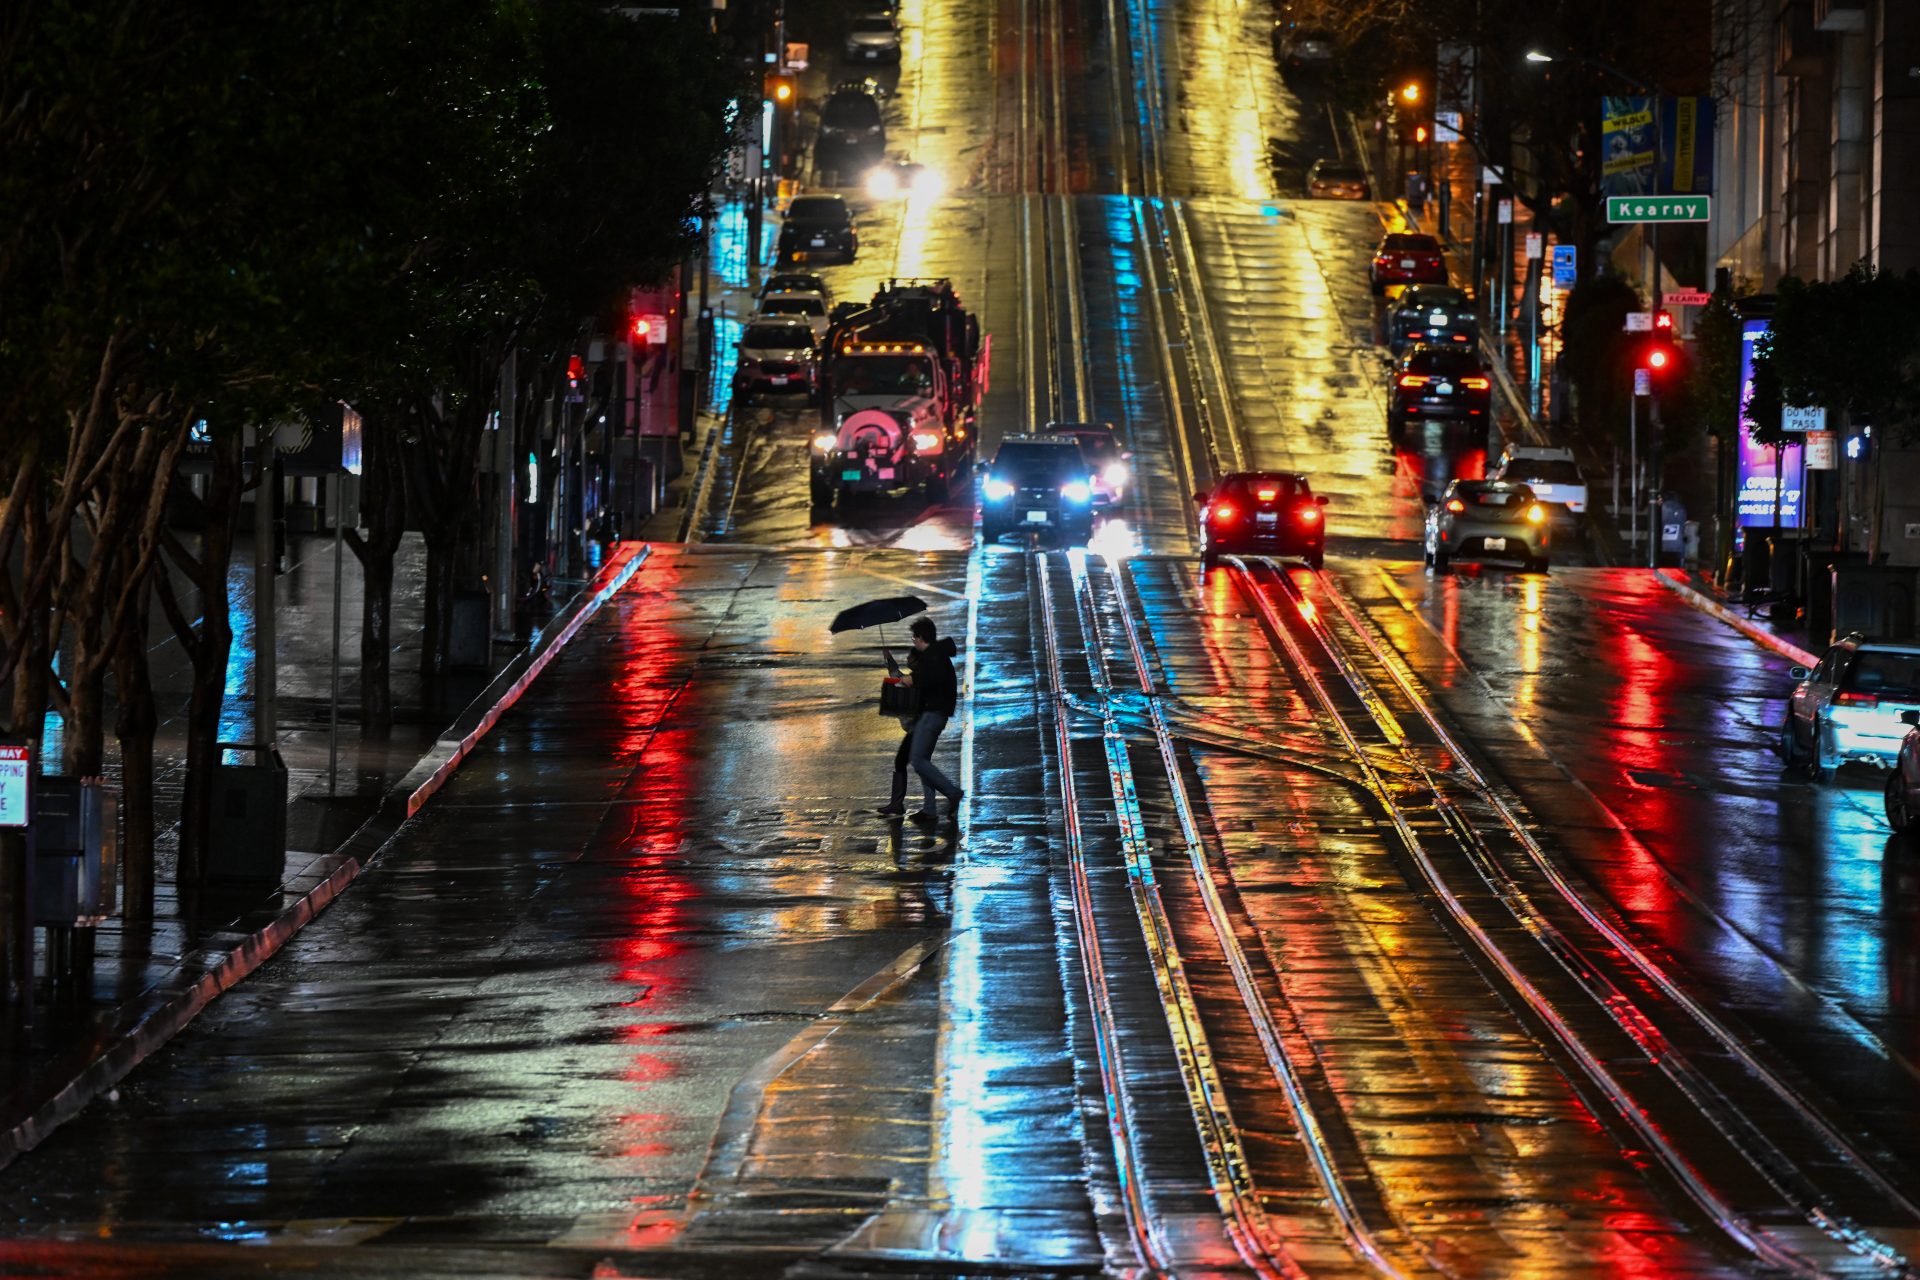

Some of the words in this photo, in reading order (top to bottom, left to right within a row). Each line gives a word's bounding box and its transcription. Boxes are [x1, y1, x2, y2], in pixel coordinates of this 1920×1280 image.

[1611, 113, 1646, 127] WILDLY
[1620, 203, 1696, 218] Kearny
[1787, 408, 1799, 417] DO
[1804, 408, 1822, 417] NOT
[1792, 420, 1816, 428] PASS
